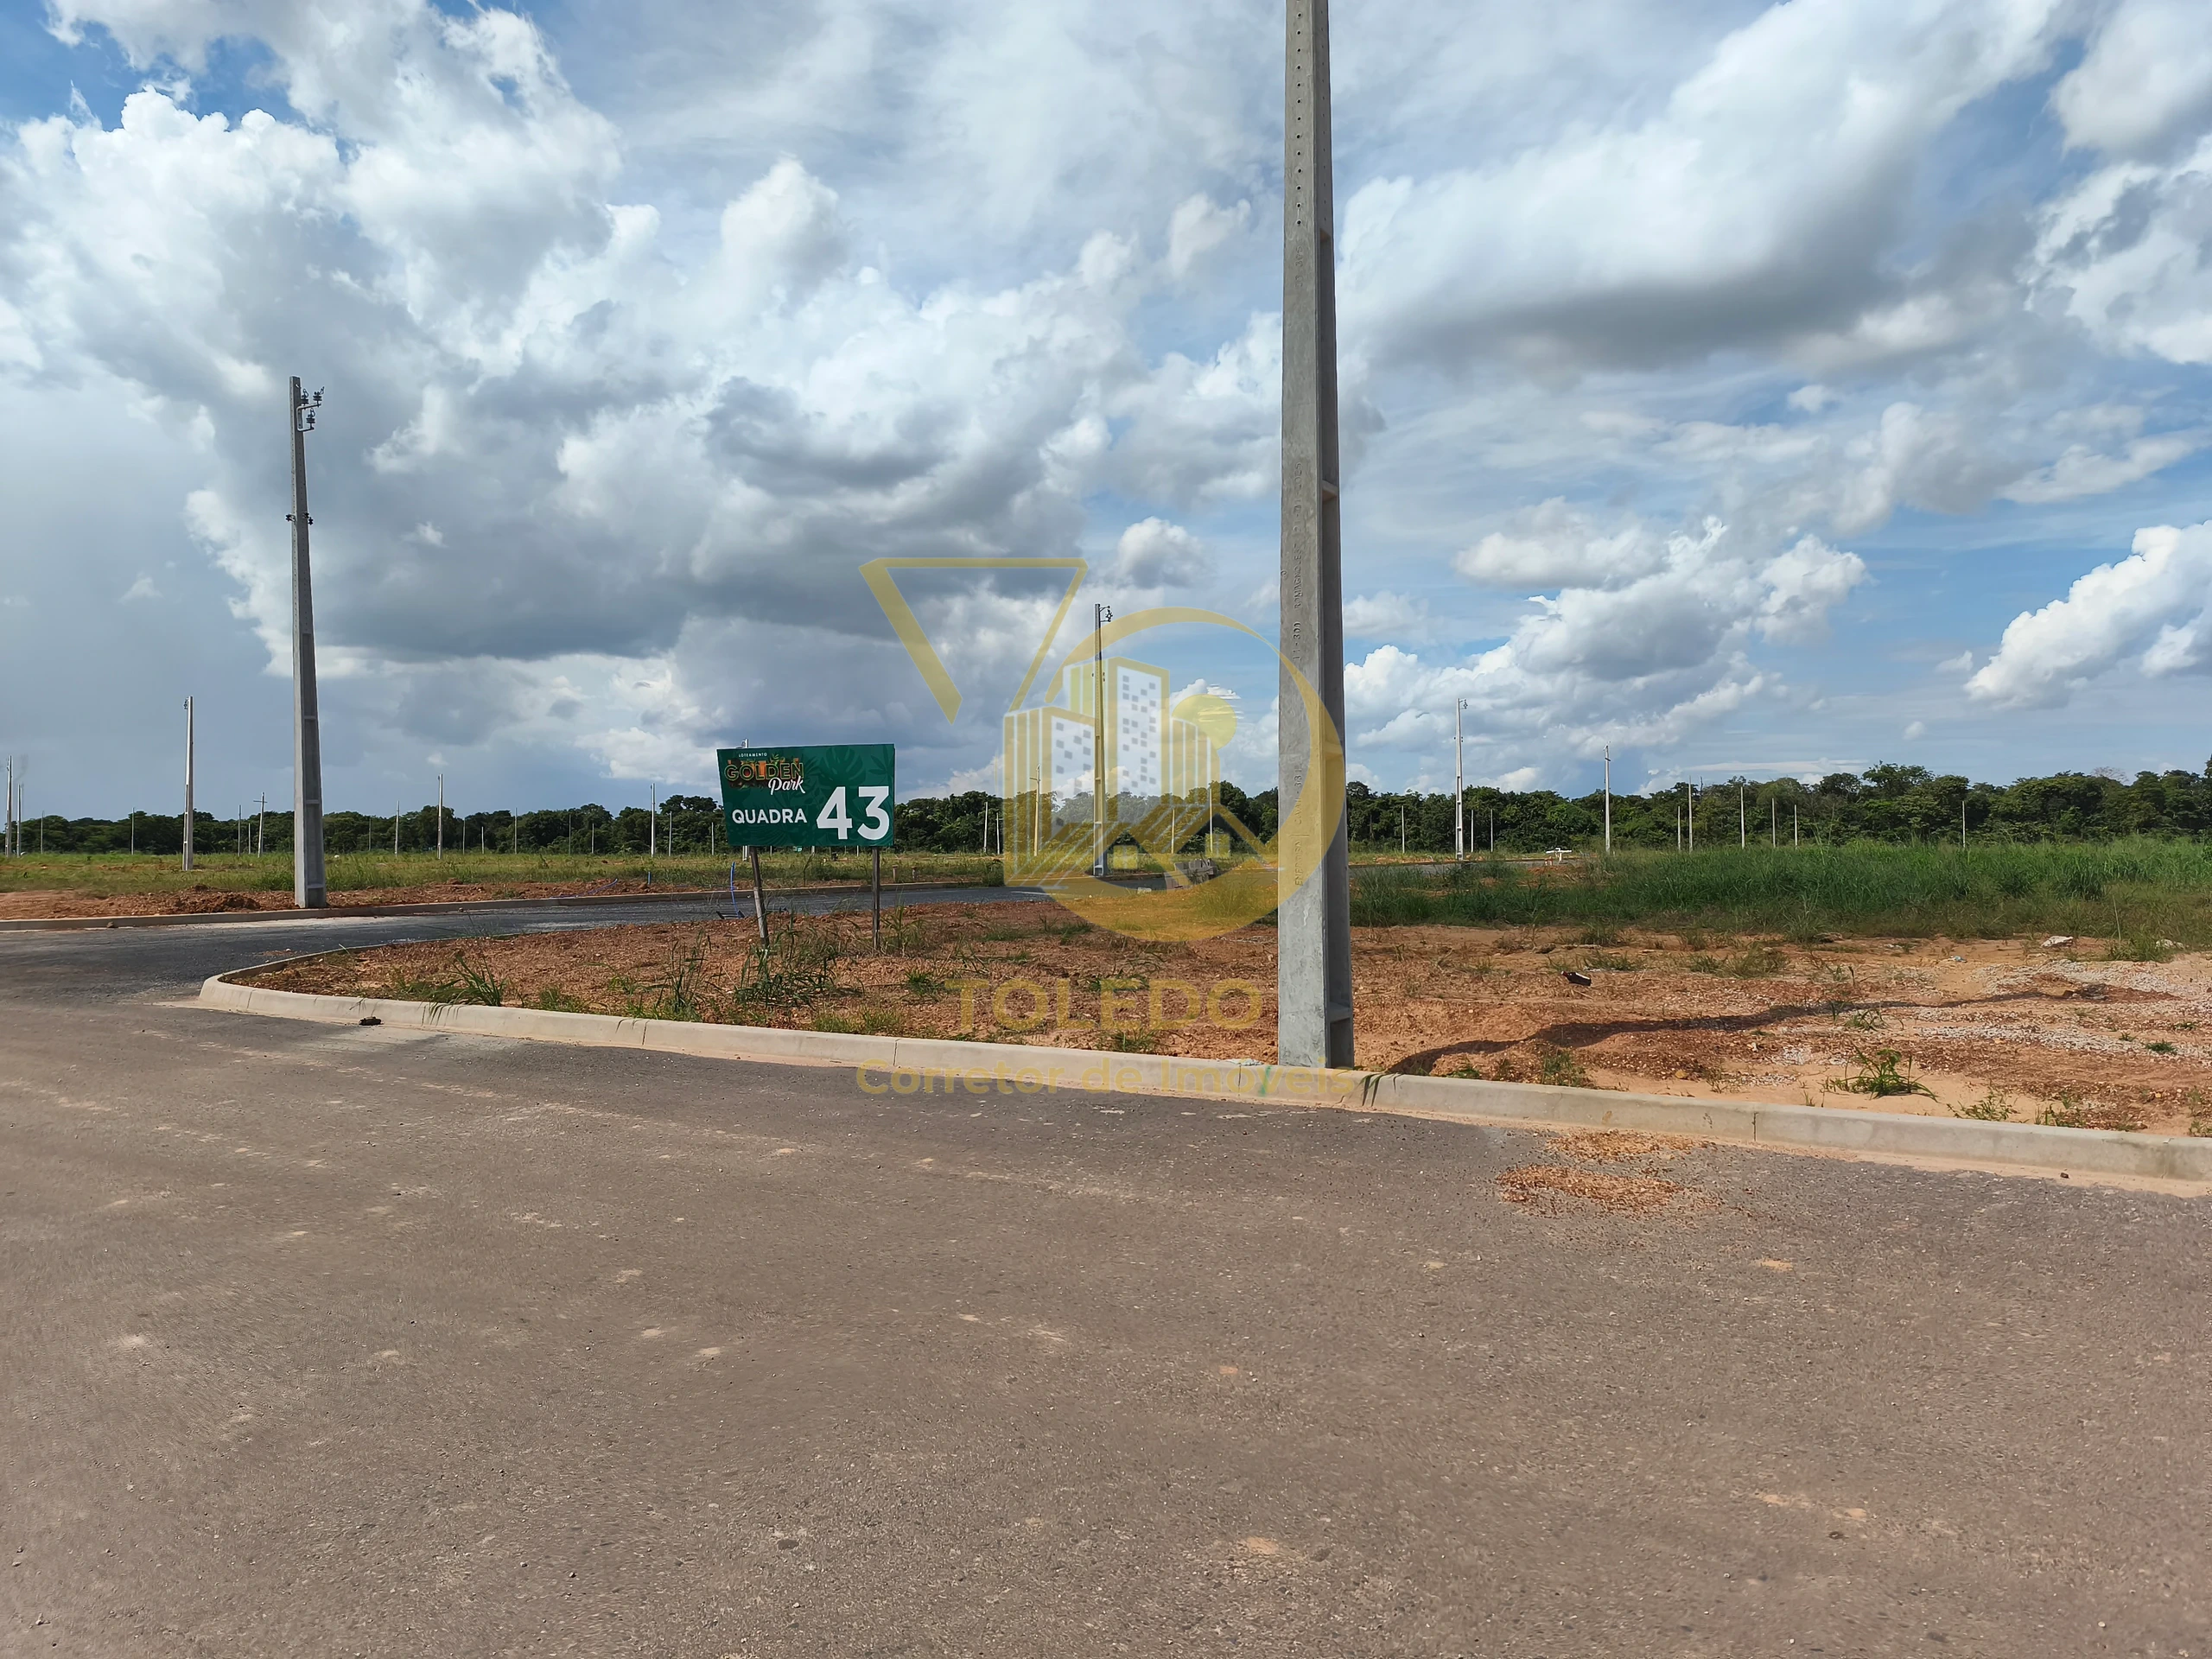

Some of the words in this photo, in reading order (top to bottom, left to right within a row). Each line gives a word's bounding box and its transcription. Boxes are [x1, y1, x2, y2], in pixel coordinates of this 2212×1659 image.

[724, 762, 804, 781] GOLDEN
[767, 776, 805, 795] Park
[732, 808, 807, 823] QUADRA
[816, 785, 890, 841] 43
